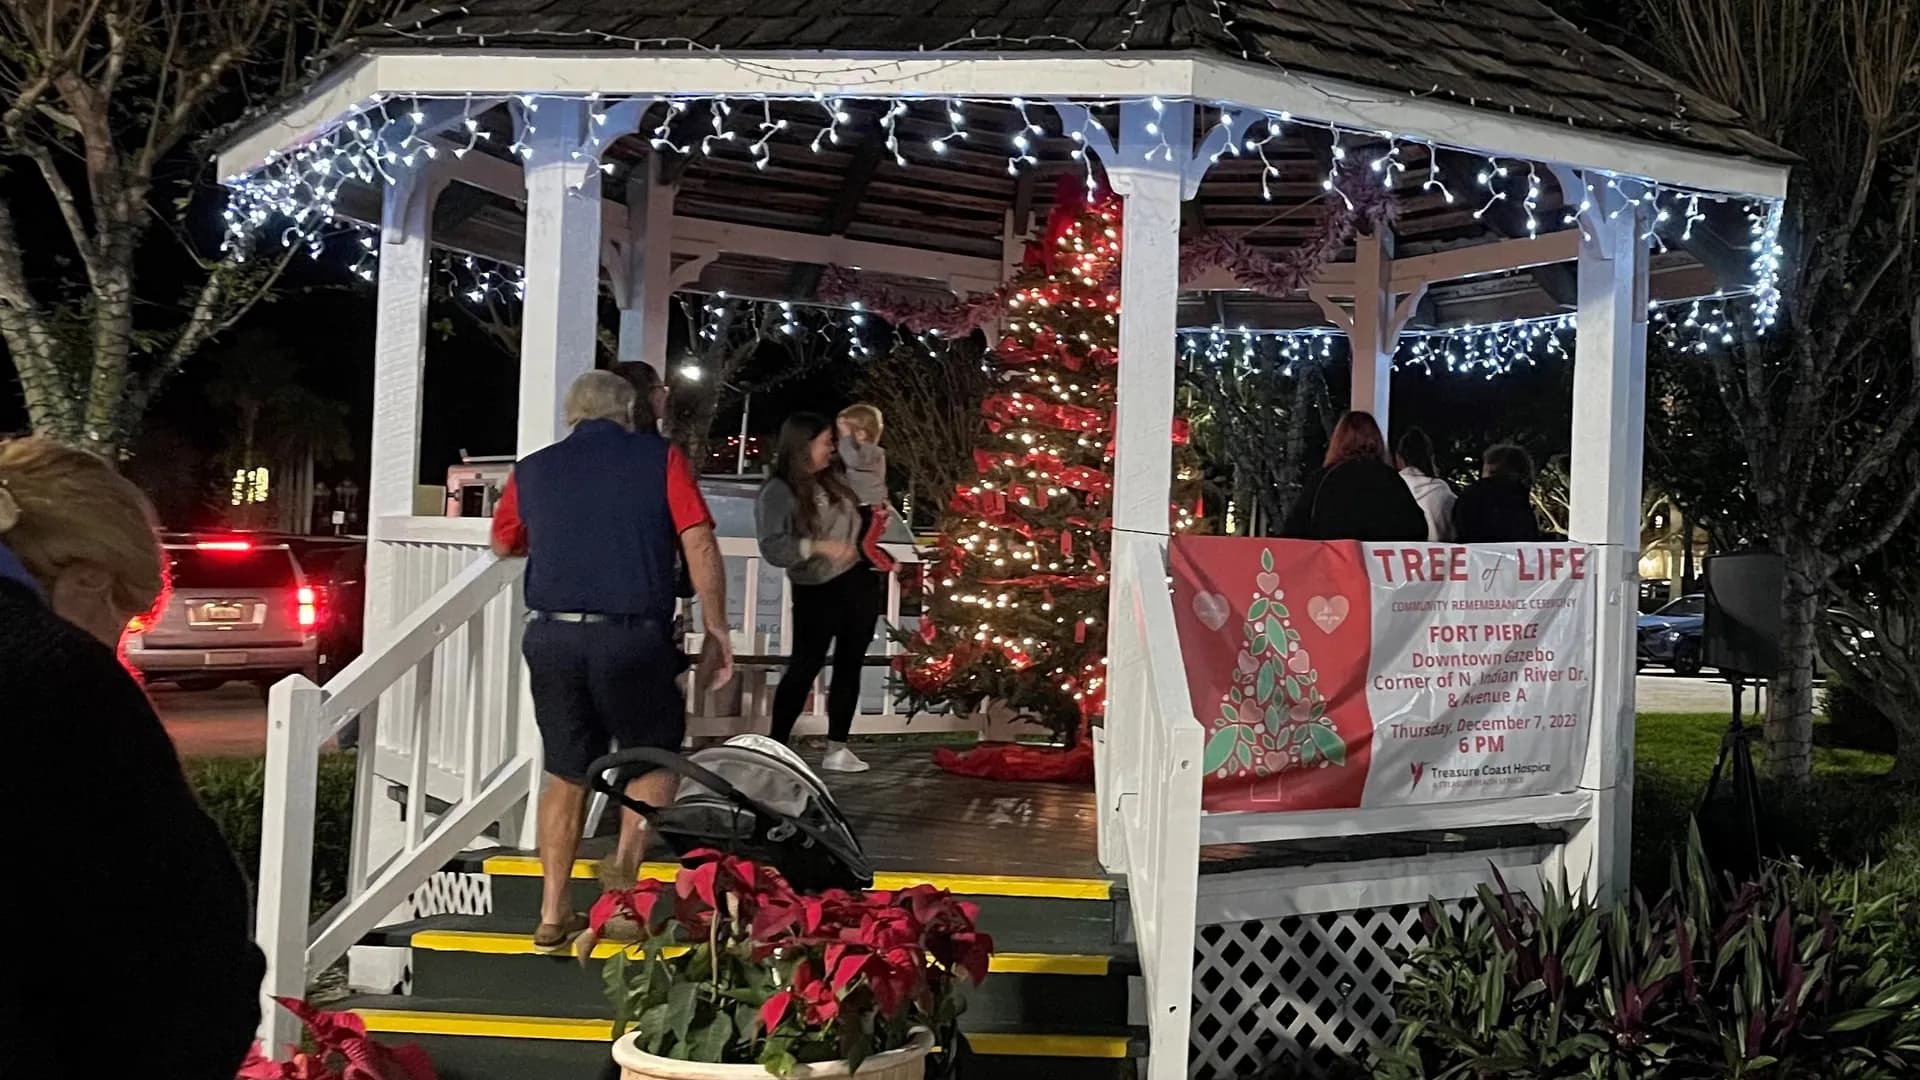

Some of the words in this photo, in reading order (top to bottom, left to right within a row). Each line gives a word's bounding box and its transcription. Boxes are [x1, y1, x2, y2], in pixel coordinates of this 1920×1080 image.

[1374, 548, 1469, 582] TREE
[1482, 555, 1502, 592] of
[1517, 548, 1585, 581] LIFE
[1392, 601, 1448, 612] COMMUNITY
[1452, 600, 1527, 610] REMEMBRANCE
[1430, 625, 1478, 643] FORT
[1485, 624, 1538, 641] PIERCE
[1413, 652, 1501, 668] Downtown
[1504, 647, 1554, 662] Gazebo
[1374, 675, 1430, 690] Corner
[1437, 672, 1453, 688] of
[1459, 672, 1477, 687] N.
[1480, 670, 1518, 685] Indian
[1525, 668, 1564, 682] River
[1569, 667, 1588, 681] Dr.
[1448, 693, 1458, 708] &
[1461, 690, 1510, 706] Avenue
[1516, 688, 1527, 702] A
[1391, 721, 1453, 738] Thursday,
[1458, 715, 1530, 732] December
[1534, 715, 1545, 732] 7,
[1550, 714, 1577, 728] 2023
[1459, 738, 1469, 753] 6
[1476, 736, 1505, 753] PM
[1432, 765, 1480, 779] Treasure
[1482, 765, 1511, 775] Coast
[1513, 762, 1551, 775] Hospice
